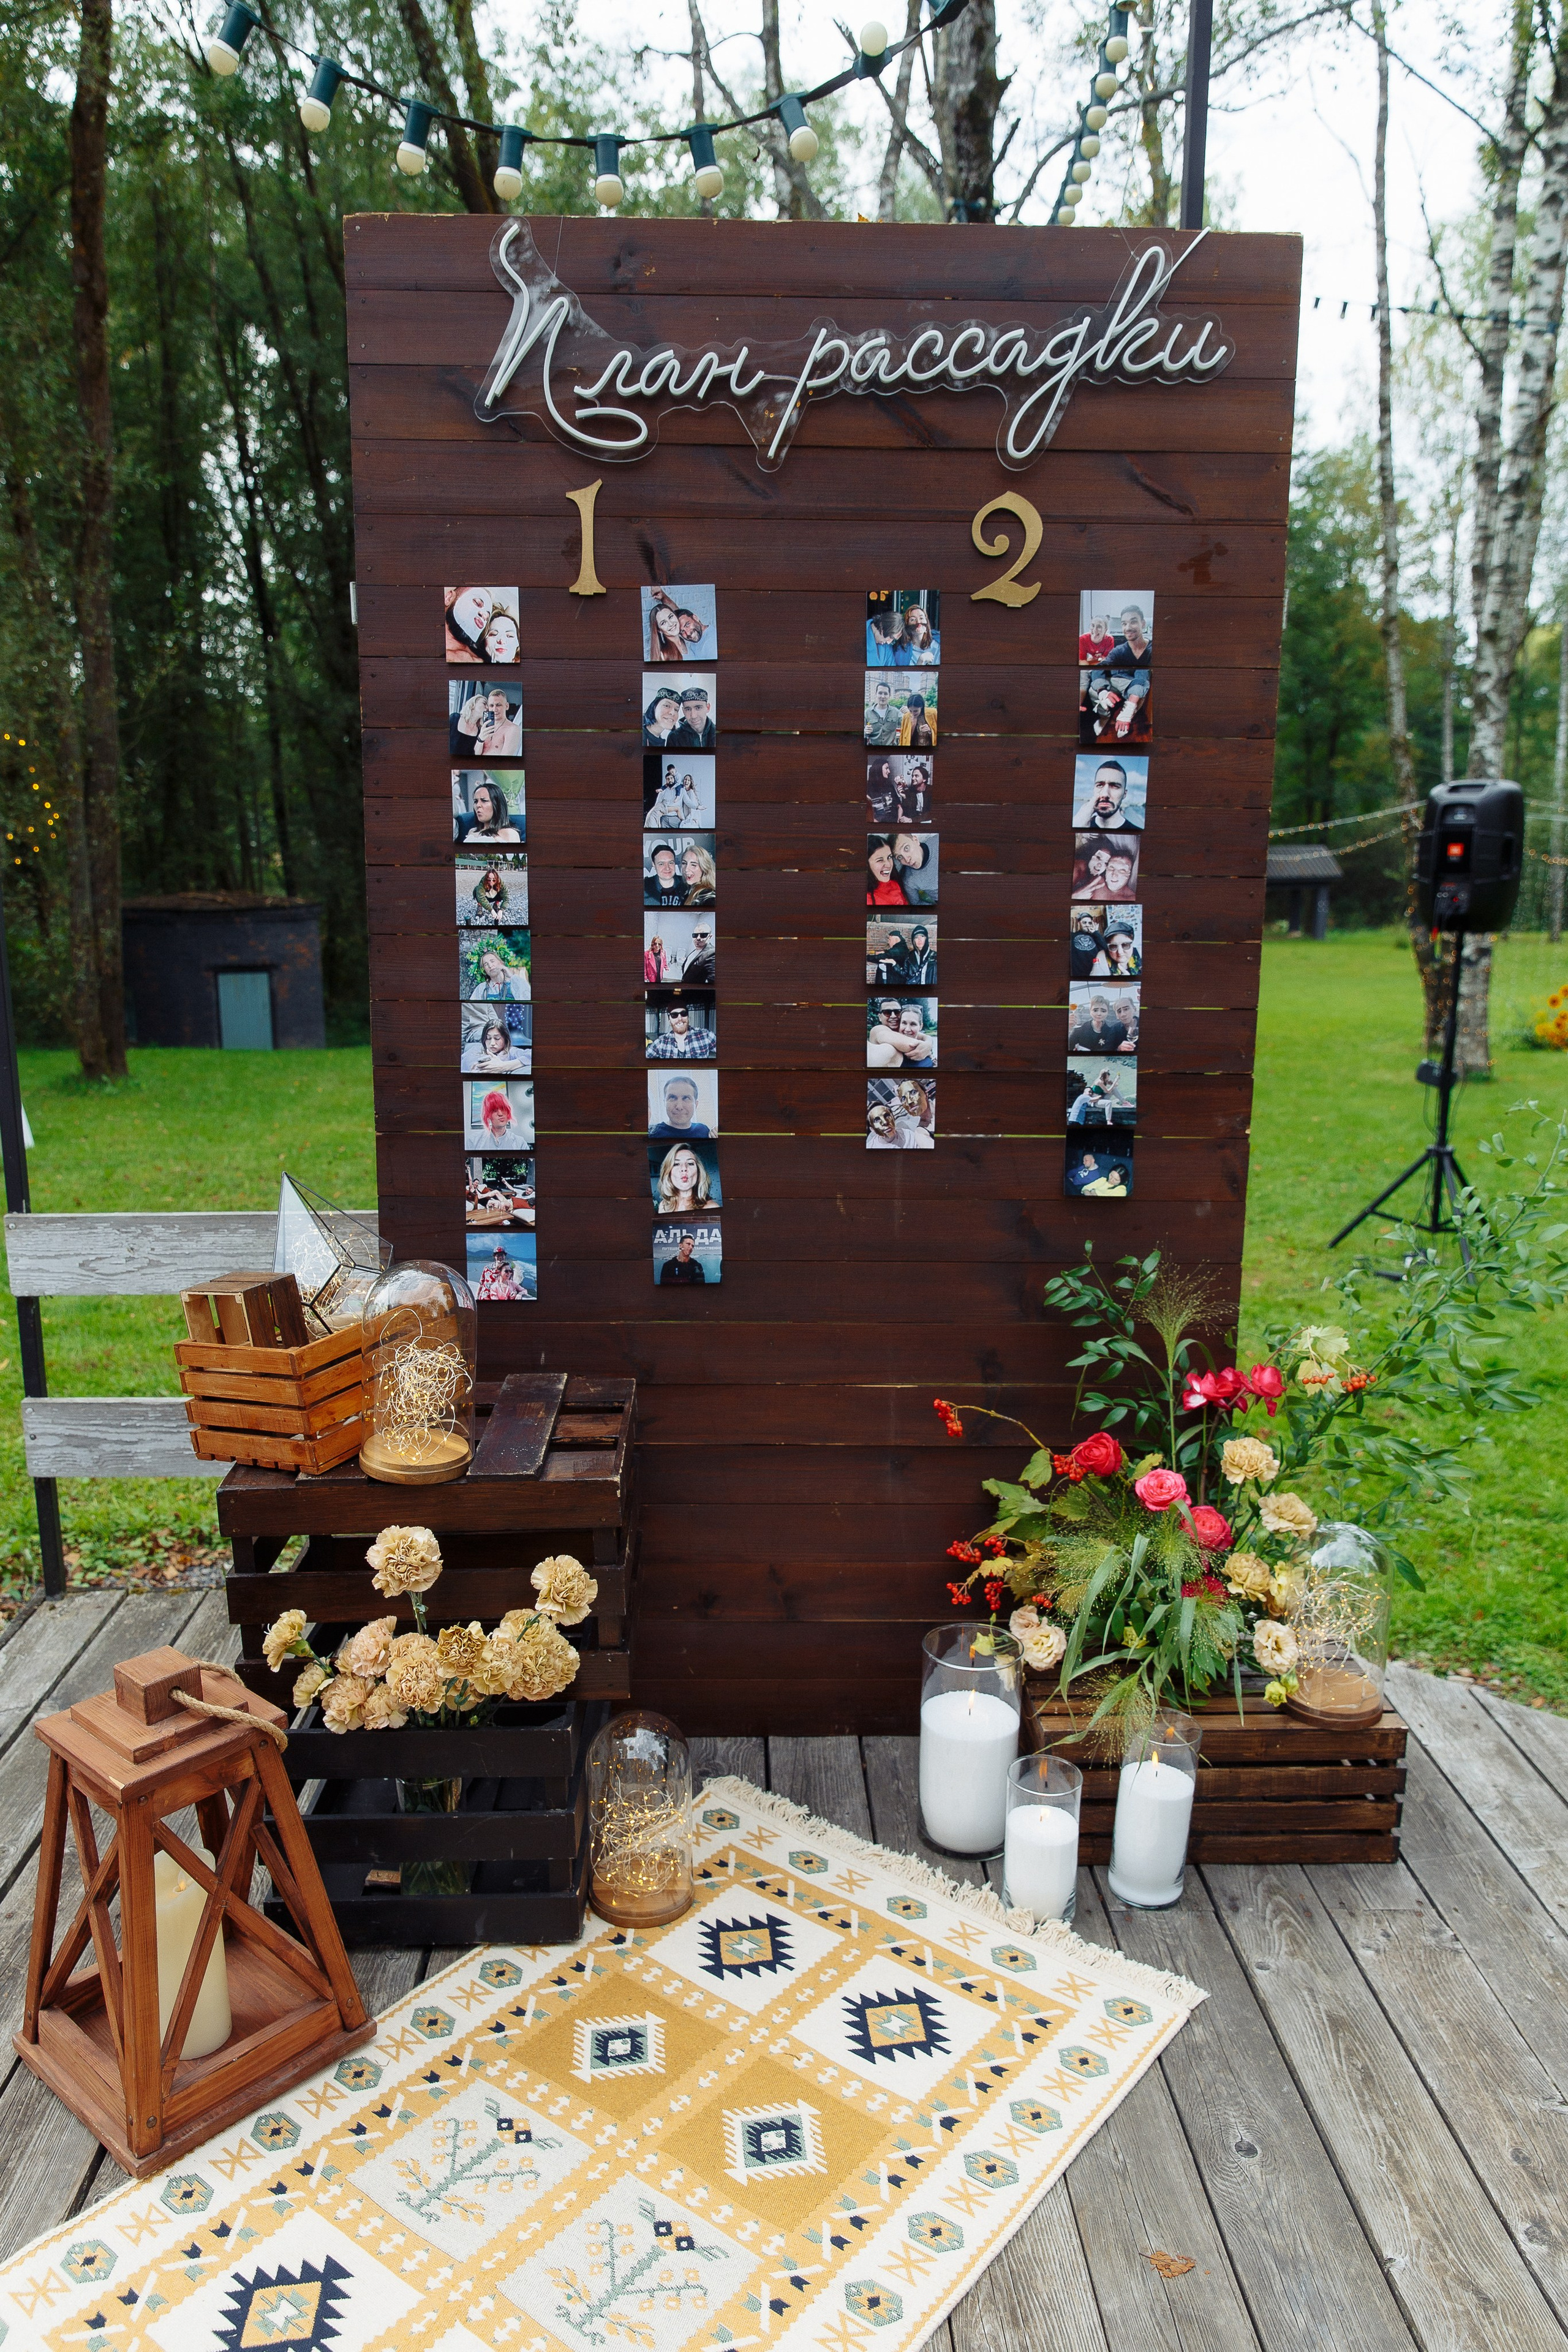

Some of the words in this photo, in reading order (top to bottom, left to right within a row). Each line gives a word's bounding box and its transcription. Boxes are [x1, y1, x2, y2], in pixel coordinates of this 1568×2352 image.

[484, 223, 767, 450] План
[766, 225, 1228, 461] рассадки
[565, 478, 607, 595] 1
[970, 490, 1043, 608] 2
[661, 895, 681, 906] DIG
